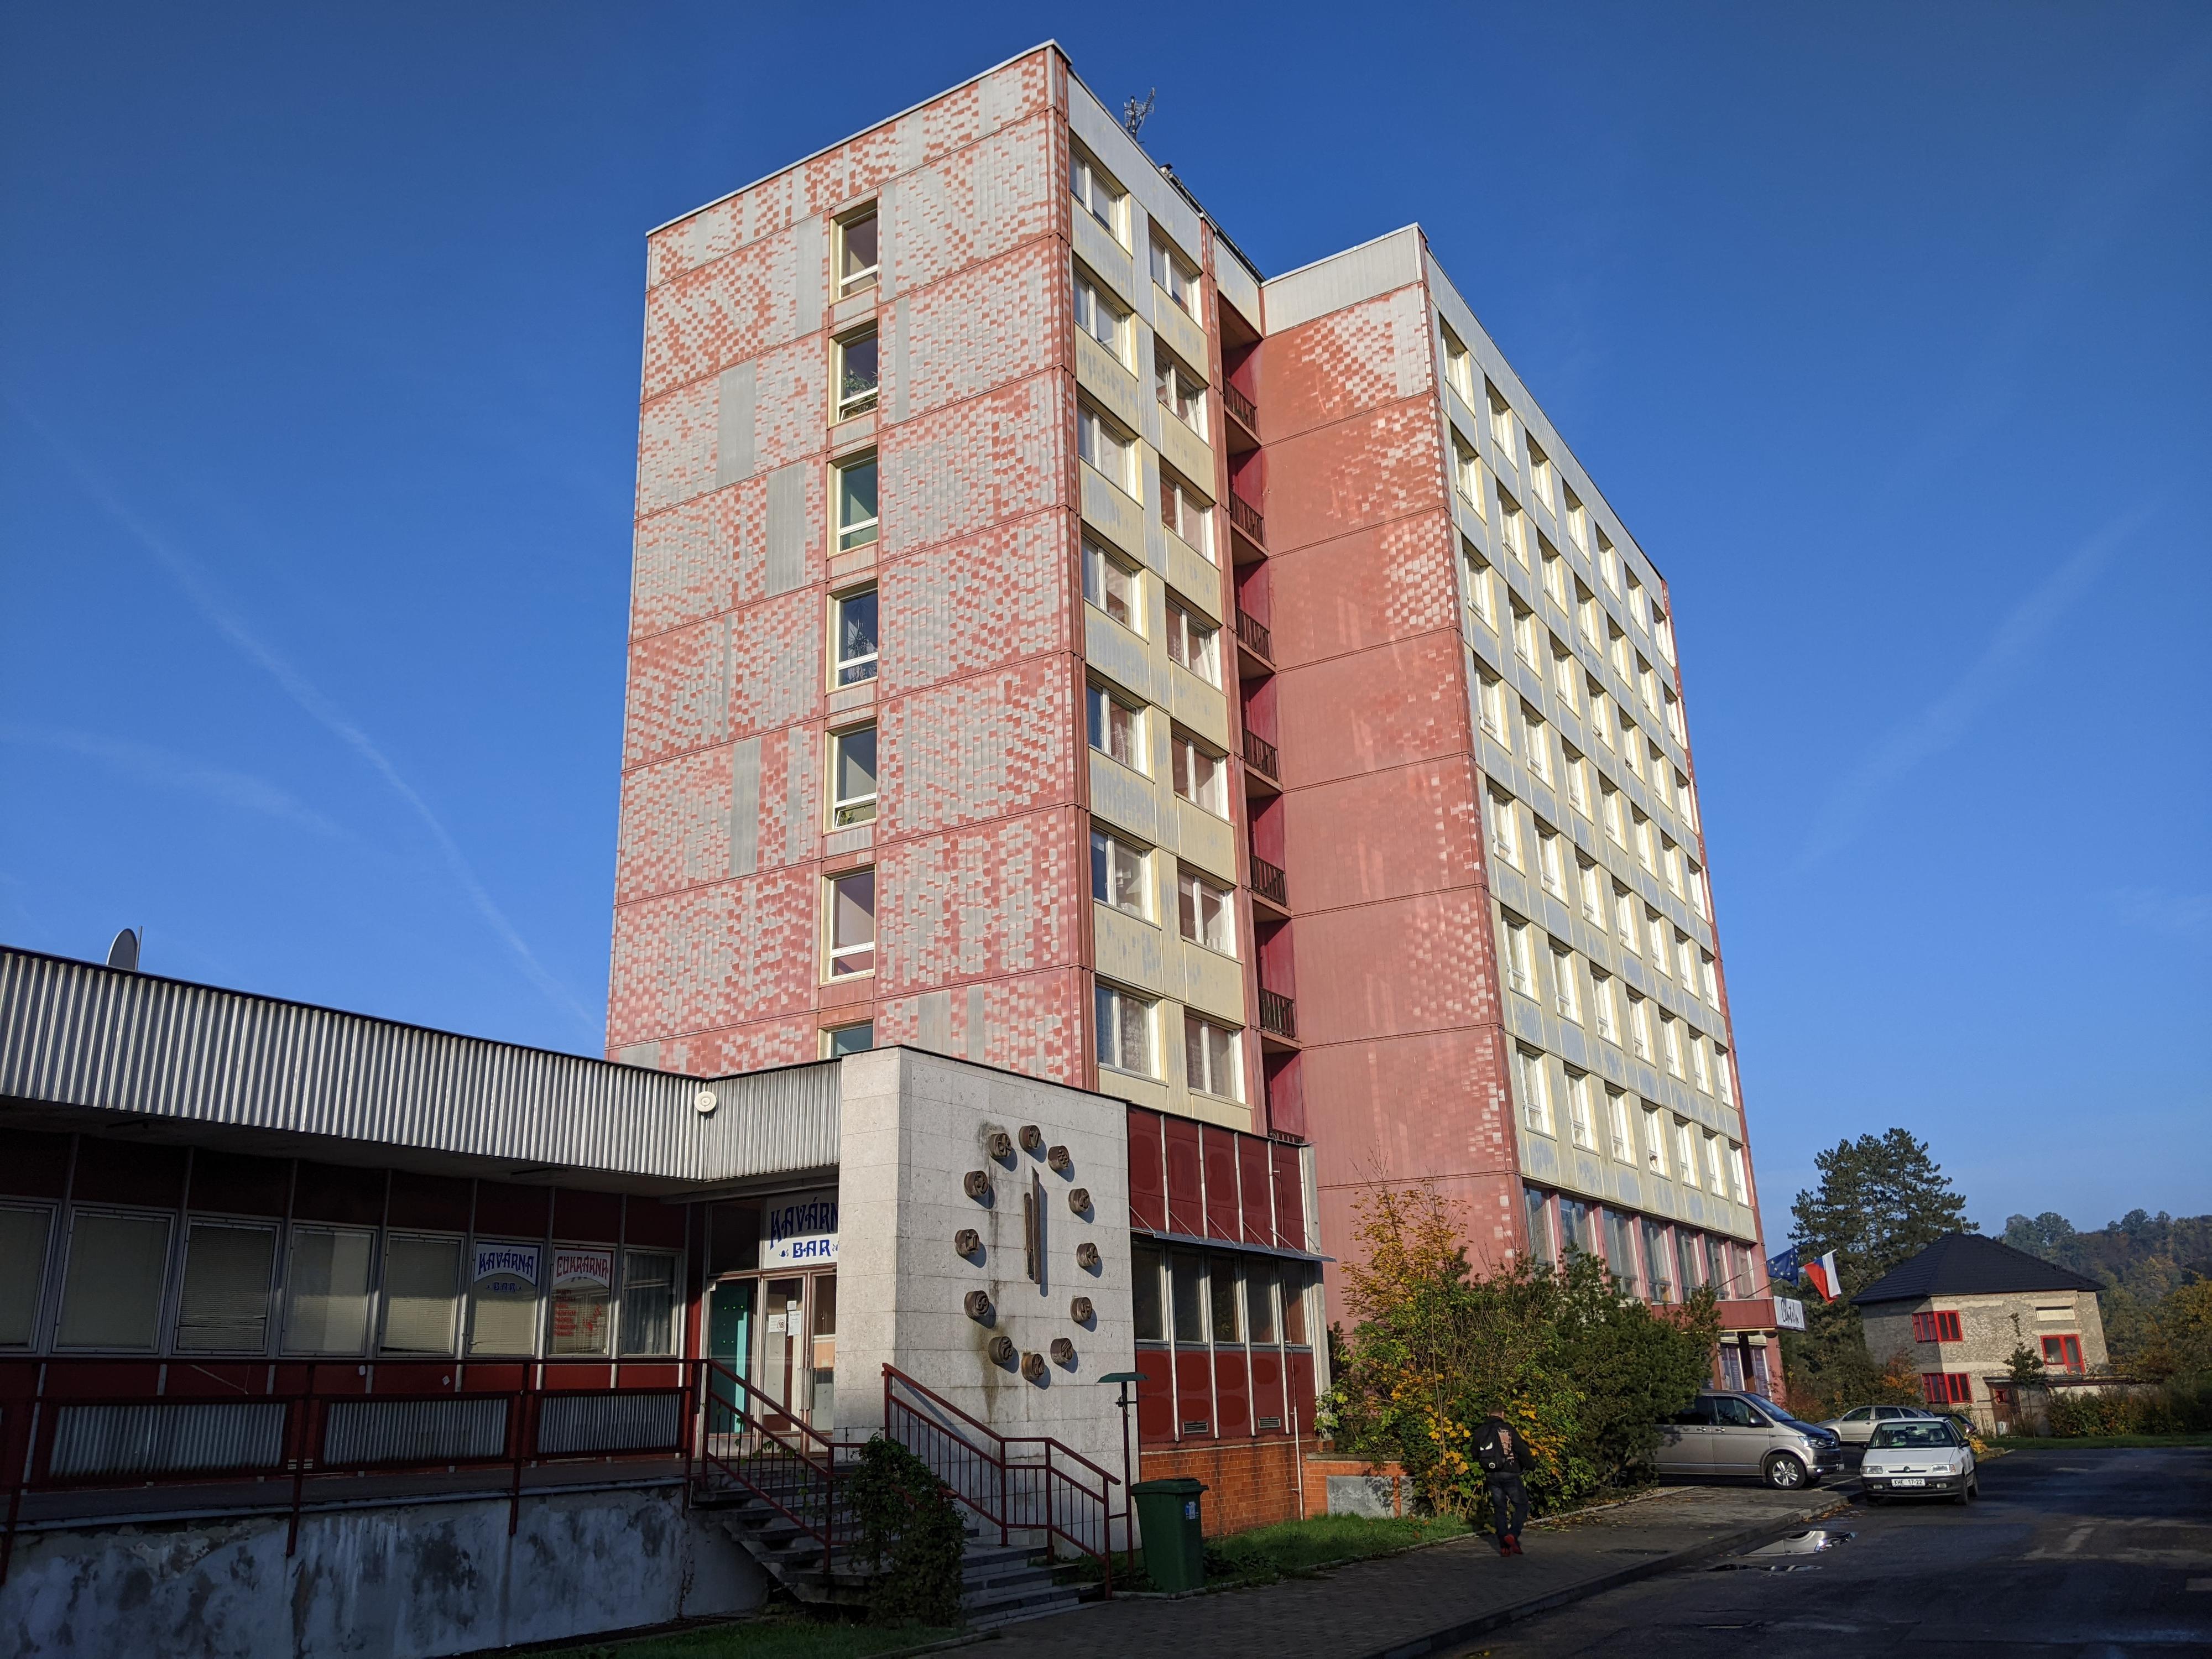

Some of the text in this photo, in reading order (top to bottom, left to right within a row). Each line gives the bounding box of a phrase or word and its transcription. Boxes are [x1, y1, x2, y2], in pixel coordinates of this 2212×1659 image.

[792, 1239, 832, 1258] BAR
[478, 1249, 534, 1277] KAVÁRNA
[556, 1255, 609, 1280] CUKRÁRNA
[494, 1282, 516, 1292] BAR
